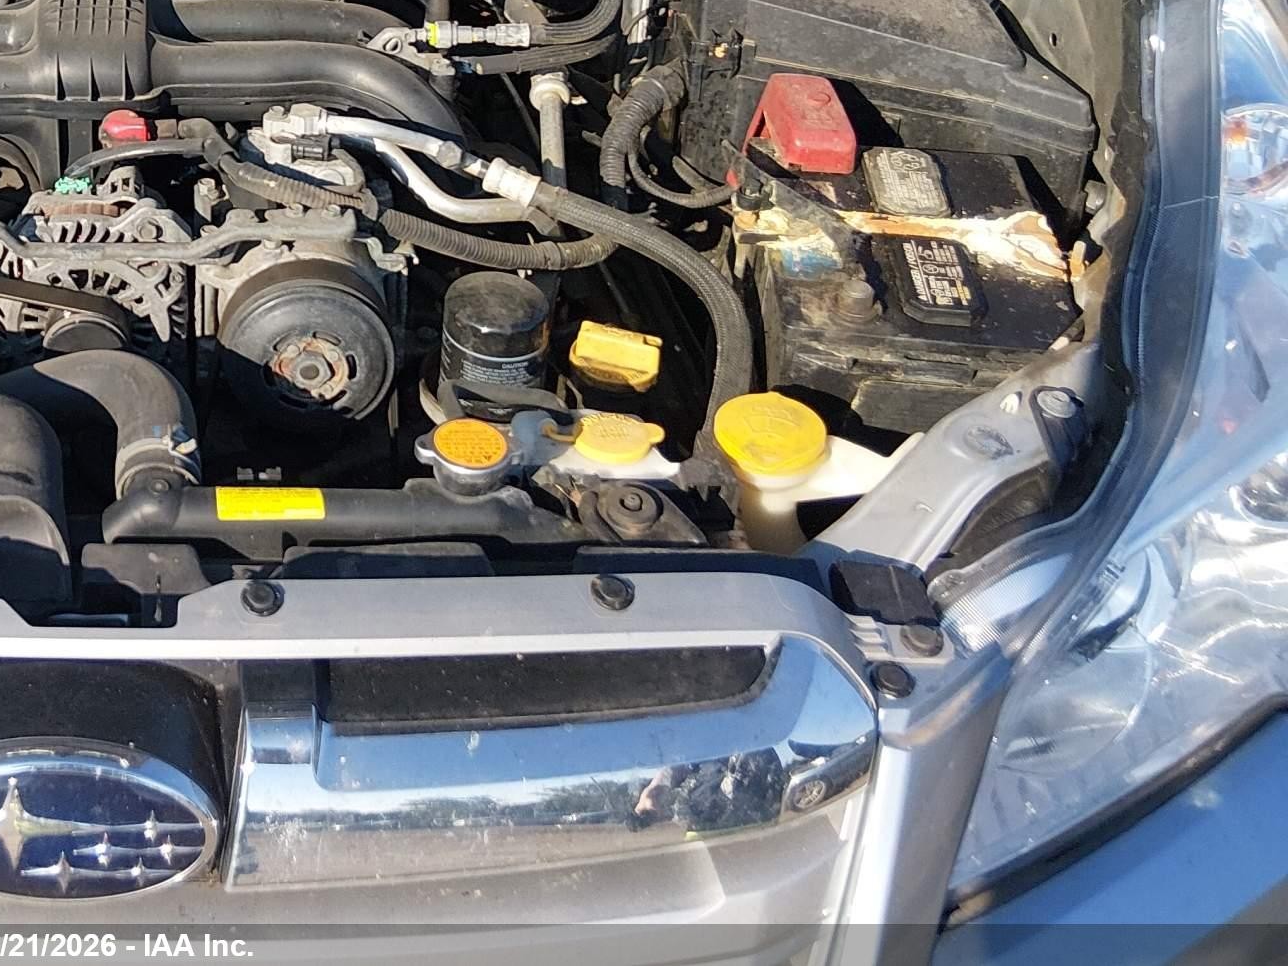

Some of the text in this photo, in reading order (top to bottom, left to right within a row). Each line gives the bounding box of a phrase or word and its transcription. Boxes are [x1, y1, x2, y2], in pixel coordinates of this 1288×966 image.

[902, 242, 917, 265] POISON
[910, 269, 926, 295] DANGER
[501, 361, 529, 369] CAUTION
